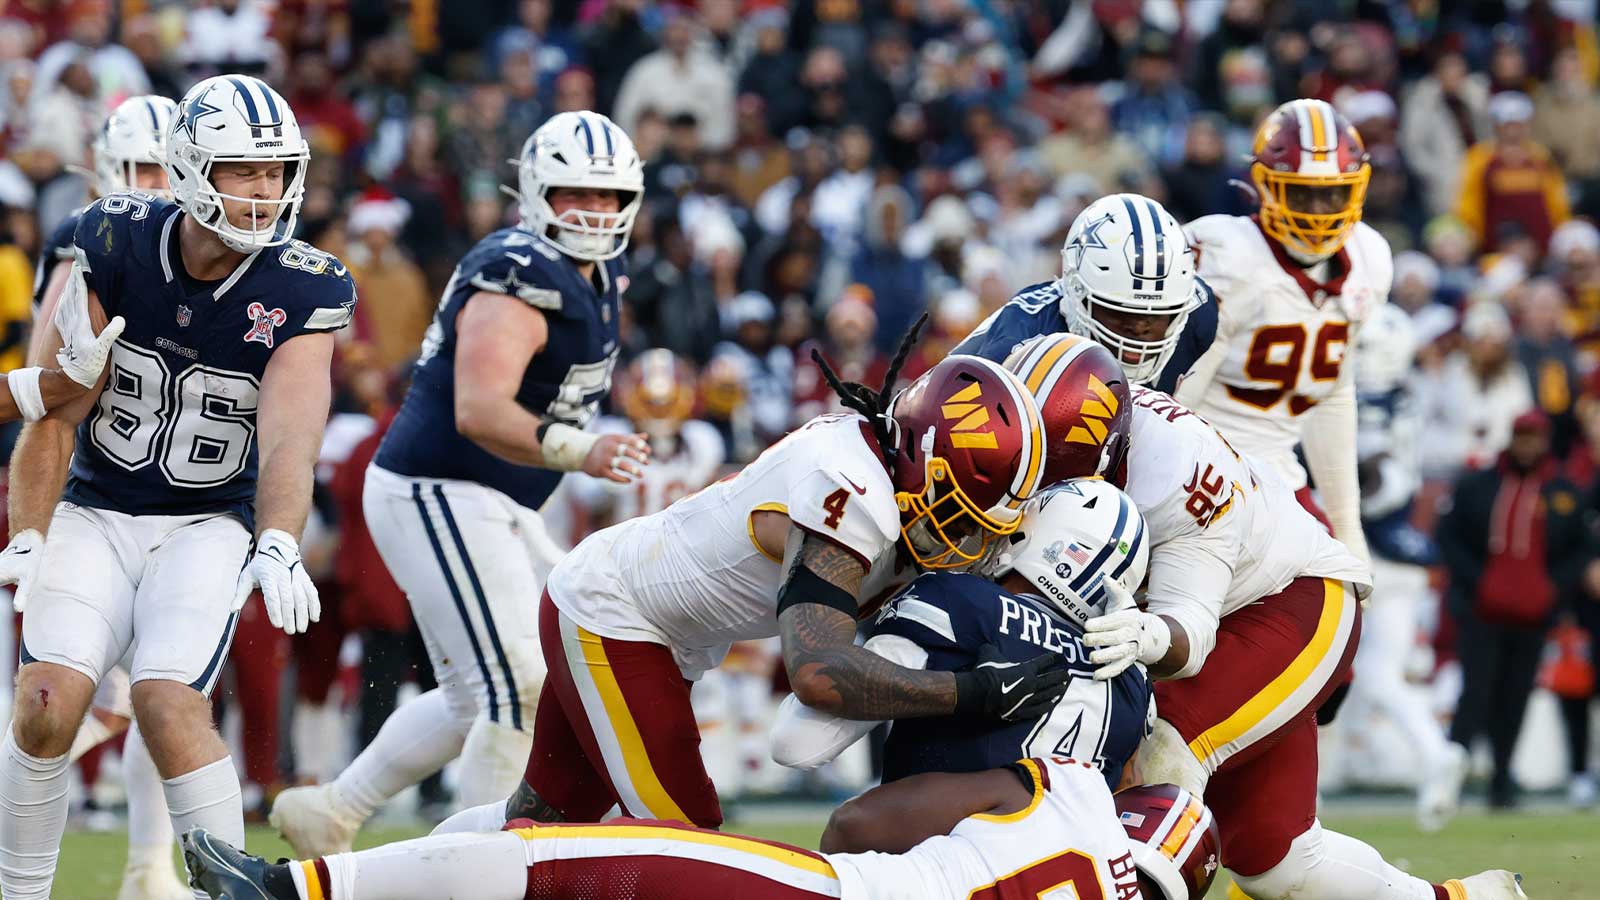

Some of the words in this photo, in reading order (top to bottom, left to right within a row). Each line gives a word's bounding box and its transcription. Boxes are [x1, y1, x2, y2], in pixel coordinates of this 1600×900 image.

[91, 337, 260, 488] 86
[823, 487, 852, 532] 4
[1037, 575, 1077, 611] CHOOSE
[1056, 564, 1072, 578] 94
[1020, 668, 1113, 771] 4
